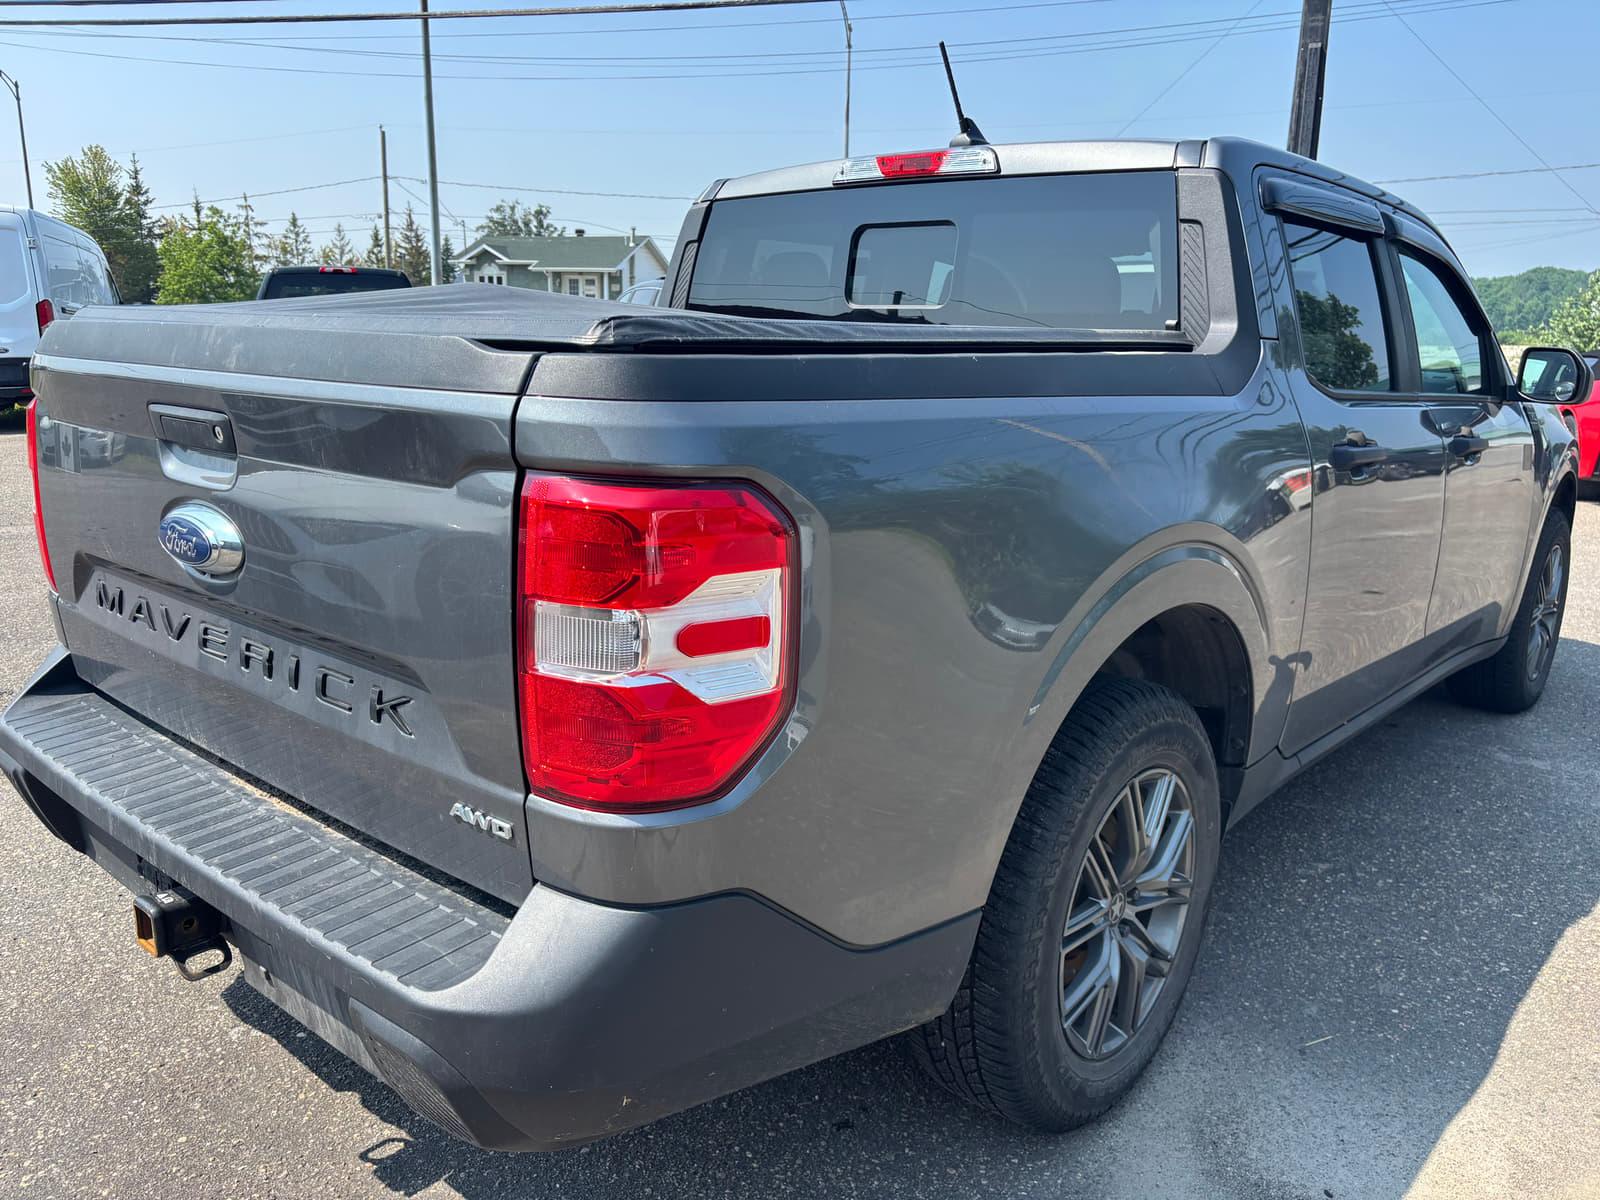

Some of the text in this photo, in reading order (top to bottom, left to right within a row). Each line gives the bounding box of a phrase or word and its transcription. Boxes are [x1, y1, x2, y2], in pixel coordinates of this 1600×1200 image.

[165, 522, 198, 558] Ford
[95, 578, 415, 739] MAVERICK
[449, 802, 513, 840] AWD
